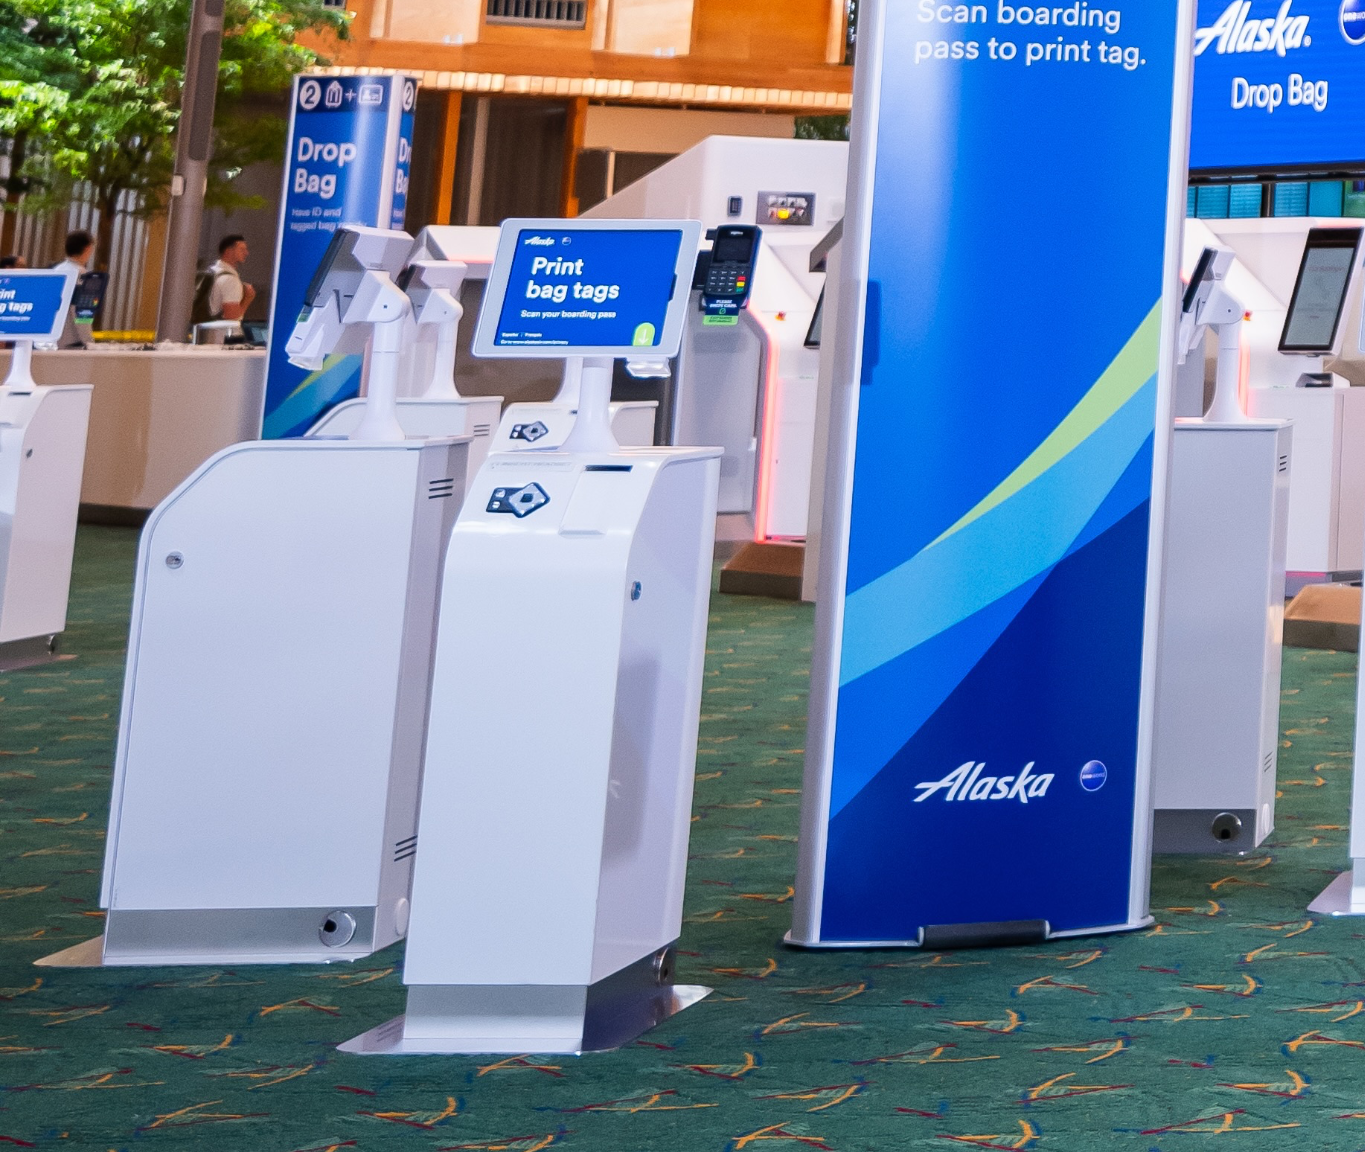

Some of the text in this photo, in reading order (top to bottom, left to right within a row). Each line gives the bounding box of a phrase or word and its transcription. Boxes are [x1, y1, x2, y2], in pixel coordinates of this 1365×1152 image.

[997, 0, 1122, 34] boarding
[914, 38, 1147, 71] pass to print tag.
[305, 85, 315, 105] 2
[1231, 73, 1328, 113] Drop Bag
[298, 137, 357, 167] Drop
[294, 168, 337, 199] Bag
[531, 256, 584, 275] Print
[525, 280, 620, 303] bag tags
[8, 302, 33, 314] tags
[521, 309, 616, 319] Scan your boarding pass
[914, 761, 1055, 803] Alaska
